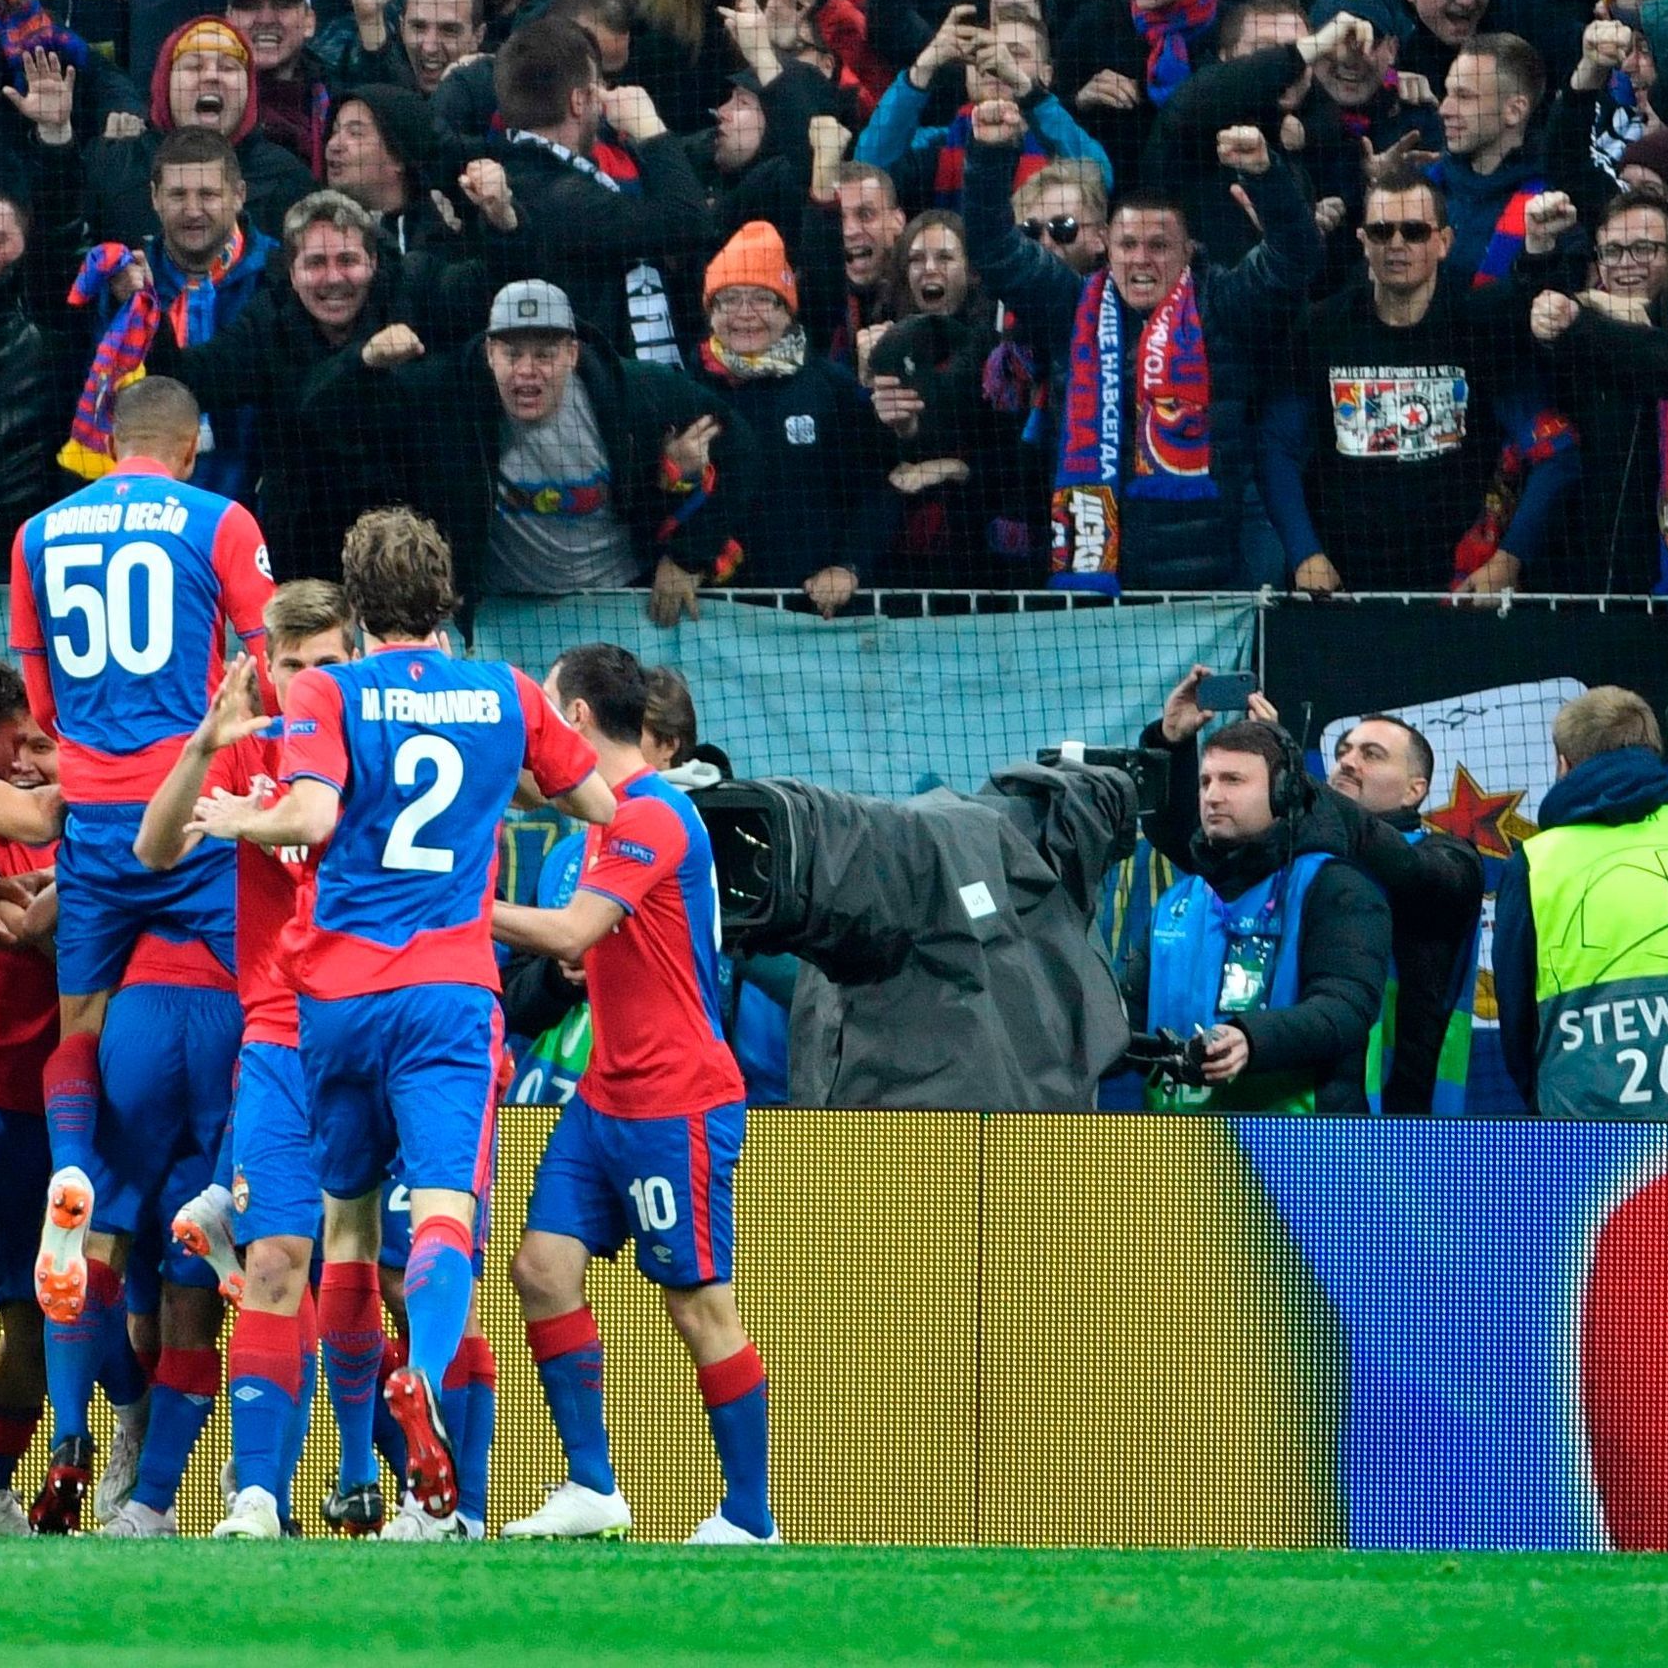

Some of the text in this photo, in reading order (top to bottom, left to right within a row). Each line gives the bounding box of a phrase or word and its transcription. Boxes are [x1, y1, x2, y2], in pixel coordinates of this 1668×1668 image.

[1100, 351, 1121, 481] НАВСЕГДА
[43, 497, 190, 541] RODRIGO BECÃO
[43, 540, 174, 680] 50
[384, 687, 502, 725] FERNANDES
[381, 733, 465, 874] 2
[628, 1175, 679, 1233] 10
